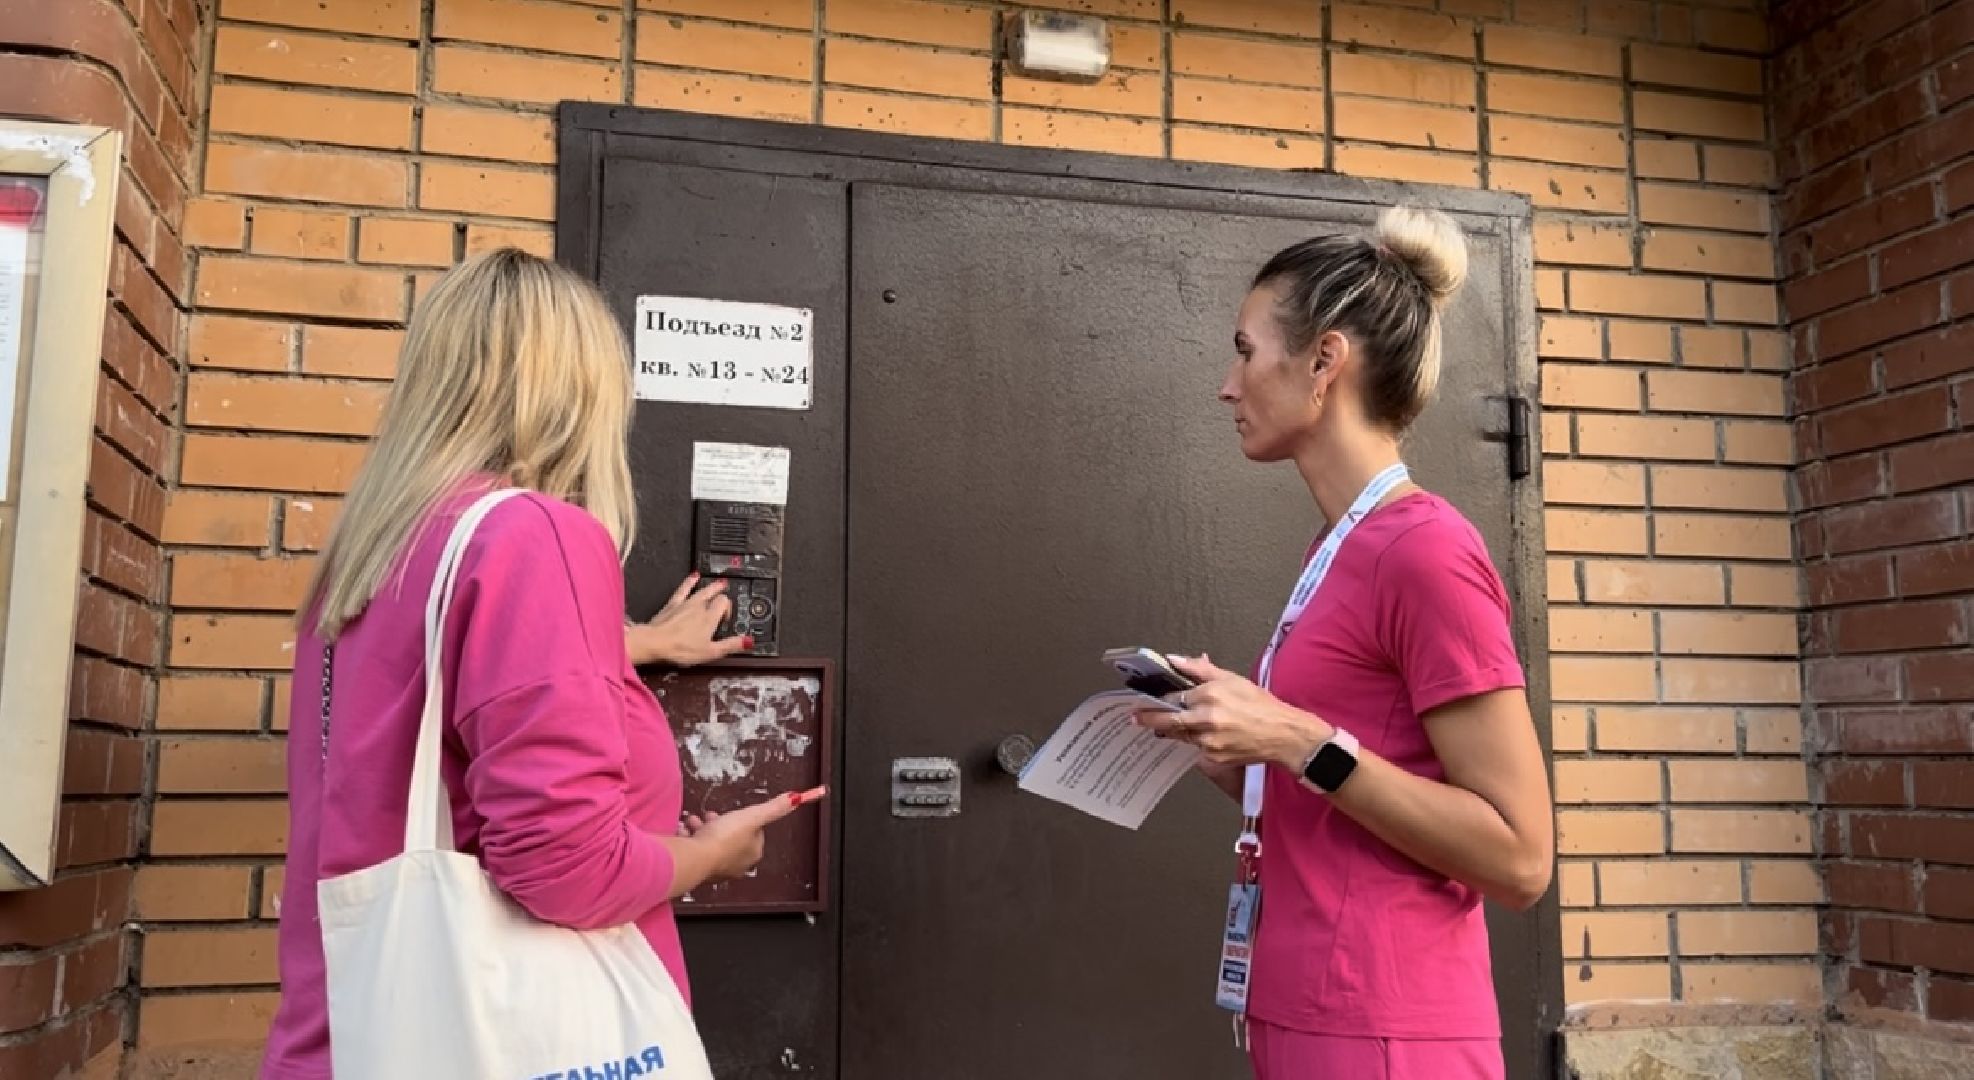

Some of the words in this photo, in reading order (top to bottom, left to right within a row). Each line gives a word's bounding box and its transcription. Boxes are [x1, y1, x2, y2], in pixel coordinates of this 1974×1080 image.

[646, 310, 761, 341] Подъезд
[770, 323, 804, 341] №2
[641, 360, 679, 377] кв.
[687, 360, 737, 380] №13
[760, 365, 809, 385] №24
